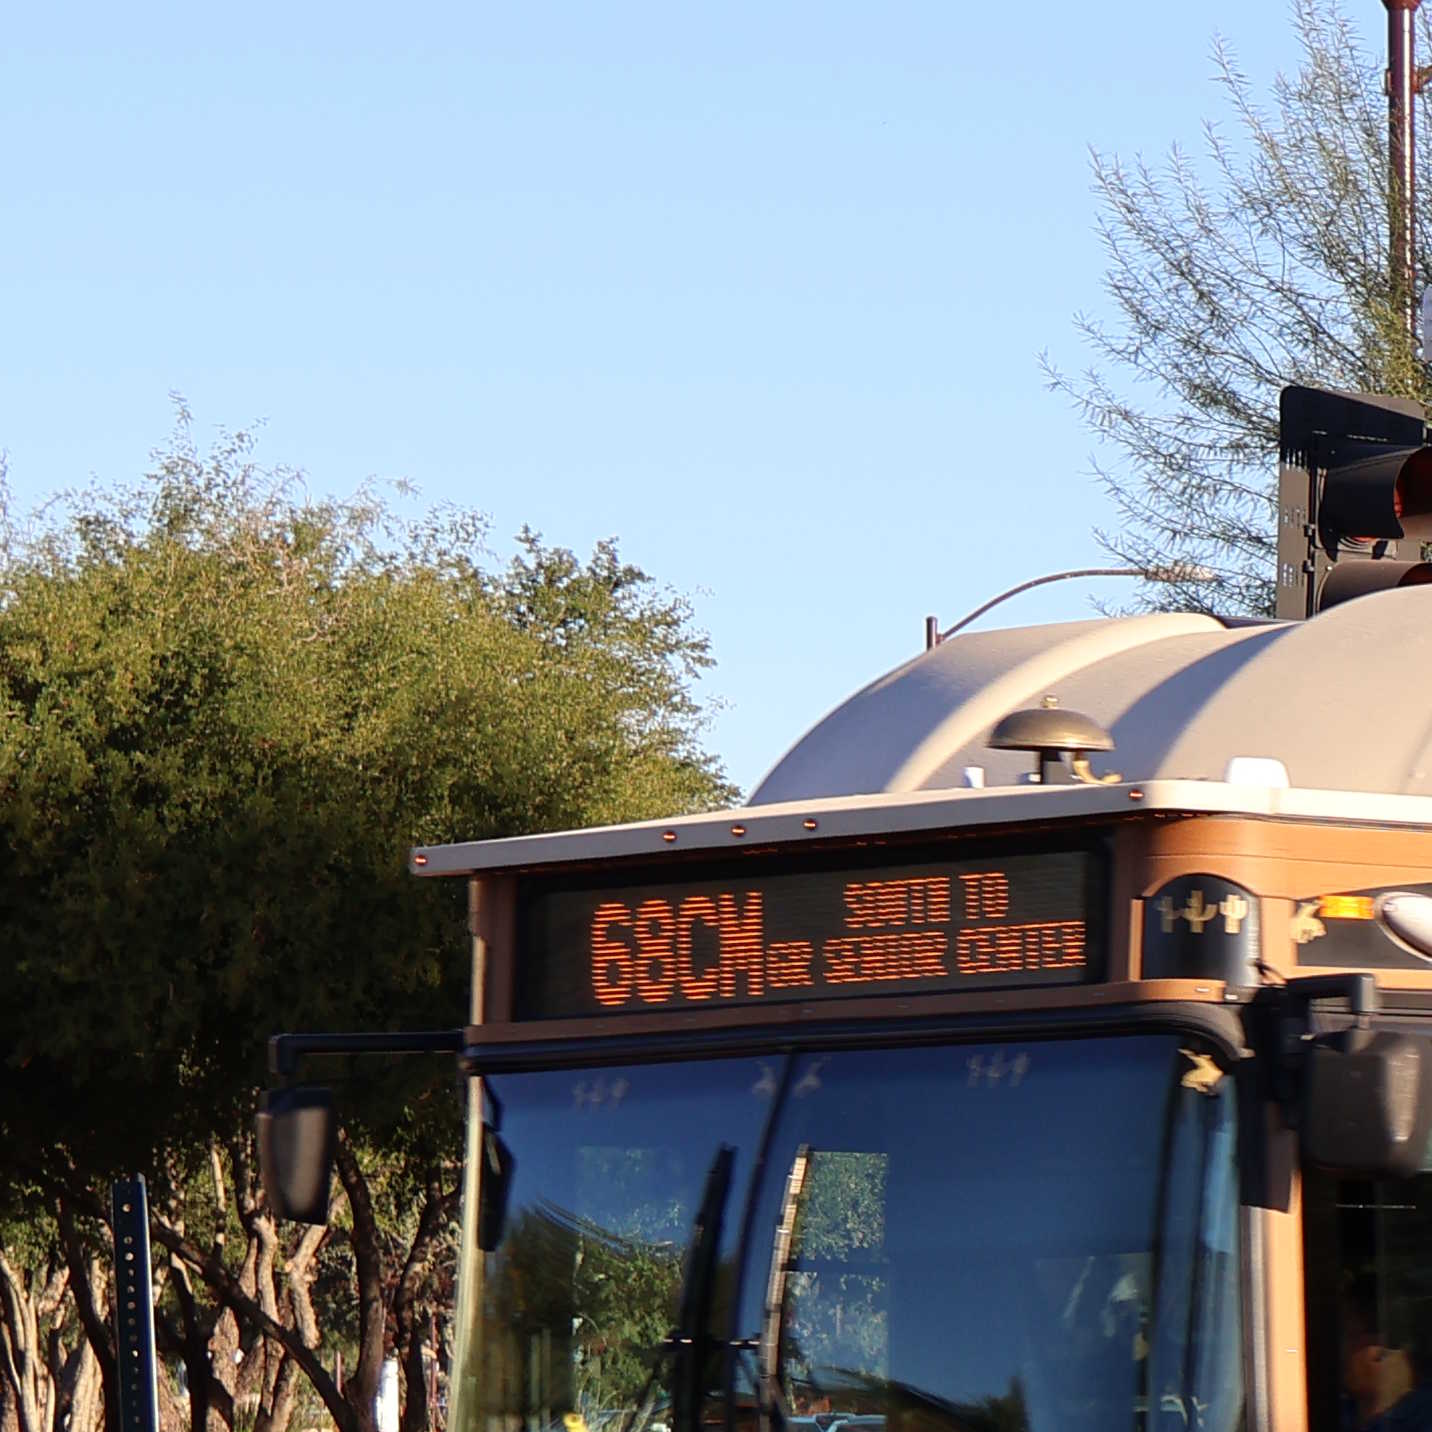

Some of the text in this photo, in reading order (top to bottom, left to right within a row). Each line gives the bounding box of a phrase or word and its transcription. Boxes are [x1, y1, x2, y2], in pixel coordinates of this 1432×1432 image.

[842, 871, 1009, 928] SOUTH TO
[591, 891, 764, 1006] 68CM
[821, 931, 949, 985] SENIOR
[956, 920, 1087, 974] CENTER
